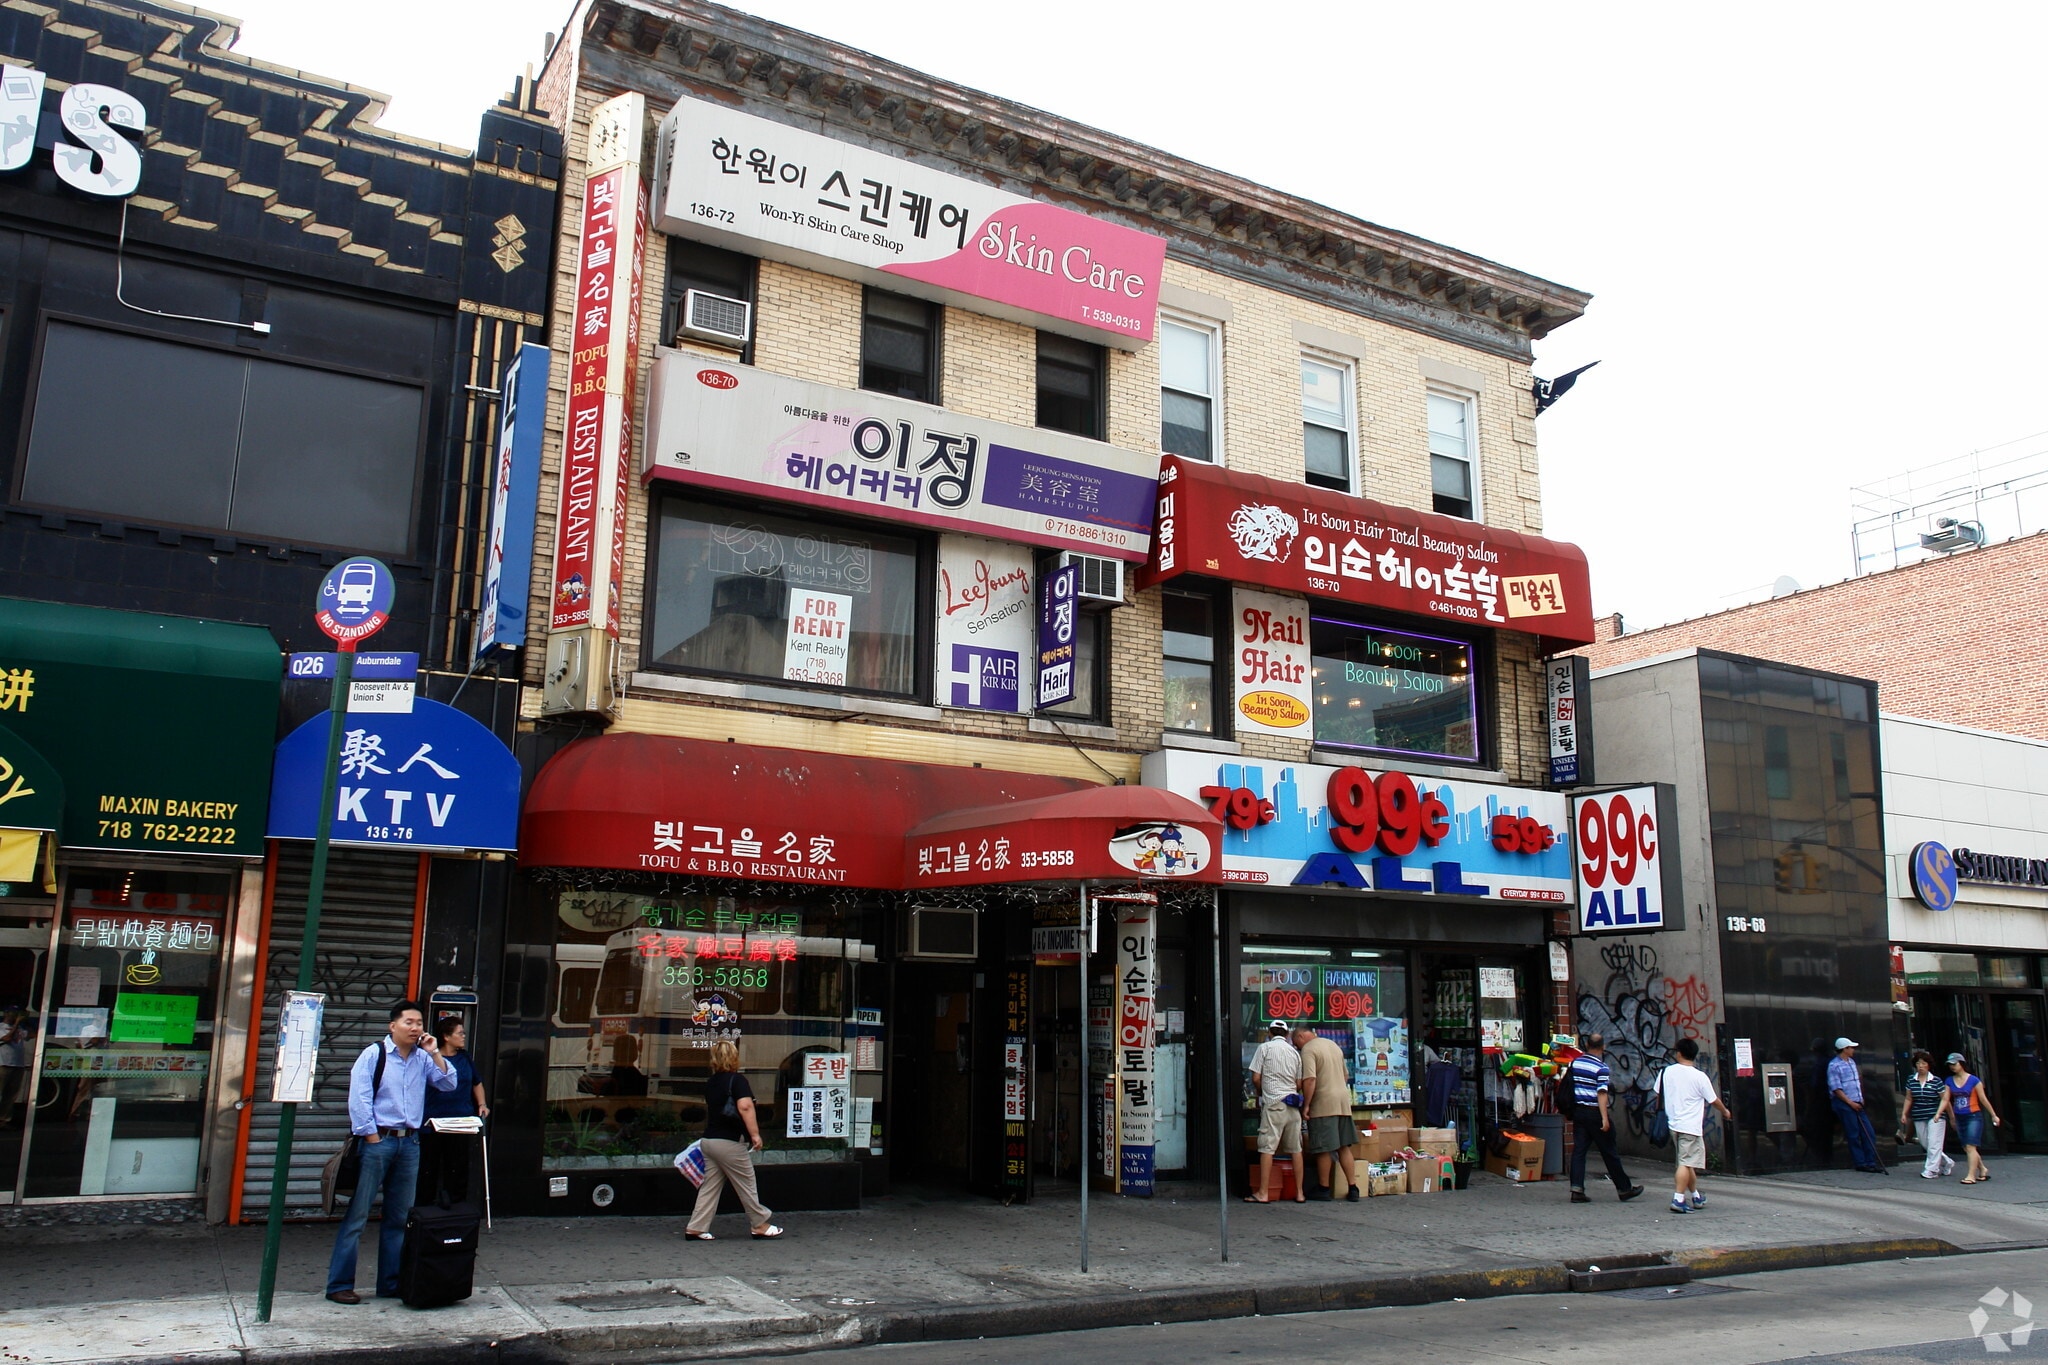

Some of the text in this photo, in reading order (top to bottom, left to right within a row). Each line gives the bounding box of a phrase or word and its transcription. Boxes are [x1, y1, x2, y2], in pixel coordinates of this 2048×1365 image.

[711, 137, 969, 249] 한원이 스킨케어
[690, 202, 735, 224] 136-72
[759, 202, 905, 254] Won-Yi Skin Care Shop
[978, 221, 1146, 299] Skin Care
[1081, 306, 1142, 331] T. 539-0313
[574, 344, 609, 365] TOFU
[585, 365, 596, 377] &
[701, 372, 736, 388] 136-70
[833, 415, 850, 427] 위한
[850, 417, 980, 510] 이정
[1023, 463, 1102, 486] LEEJOUNG SENSATION
[1159, 464, 1178, 485] 인순
[565, 406, 598, 562] RESTAURANT
[786, 453, 922, 508] 헤어커커
[1020, 473, 1100, 504] 美容室
[1018, 492, 1100, 513] HAIRSTUDIO
[1159, 492, 1174, 571] 미용실
[1302, 508, 1499, 564] In Soon Hair Total Beauty Salon
[1307, 576, 1340, 592] 136-70
[1053, 569, 1074, 643] 이정
[1509, 579, 1563, 612] 미용실
[554, 609, 590, 624] 353-5858
[805, 598, 837, 617] FOR
[967, 599, 1027, 635] Sensation
[1438, 602, 1478, 618] 461-0003
[320, 613, 382, 638] NO STANDING
[793, 615, 845, 639] RENT
[1242, 607, 1304, 645] Nail
[790, 639, 846, 658] Kent Realty
[292, 656, 324, 676] Q26
[356, 656, 402, 666] Auburndale
[806, 658, 827, 670] (718)
[1241, 648, 1305, 684] Hair
[788, 667, 843, 685] 353-8368
[982, 676, 1017, 691] KIR KIR
[1043, 671, 1068, 692] Hair
[1345, 661, 1443, 694] Beauty Salon
[353, 693, 384, 702] Union St
[354, 683, 409, 692] Roosevelt Av &
[1042, 688, 1068, 699] KIR KIR
[1243, 703, 1305, 721] Beauty Salon
[1256, 694, 1291, 708] In Soon
[340, 728, 460, 779] 聚人
[1553, 756, 1576, 765] UNISEX
[1555, 764, 1574, 773] NAILS
[100, 796, 238, 820] MAXIN BAKERY
[337, 786, 456, 827] KTV
[1200, 785, 1276, 830] 79¢
[1327, 765, 1450, 857] 99¢
[98, 821, 236, 844] 718 762-2222
[653, 820, 836, 865] 빛고을 名家
[1492, 814, 1555, 855] 59¢
[1579, 793, 1656, 888] 99¢
[918, 836, 1011, 876] 빛고을 名家
[1021, 850, 1074, 868] 353-5858
[639, 853, 847, 882] TOFU & B.B.Q RESTAURANT
[1240, 872, 1248, 880] OR
[1252, 873, 1267, 881] LESS
[1291, 852, 1490, 896] ALL
[1503, 889, 1528, 898] EVERYDAY
[1585, 887, 1662, 927] ALL
[1726, 916, 1766, 933] 136-68
[1047, 929, 1074, 950] INCOME
[663, 966, 768, 988] 353-5858
[1267, 968, 1312, 985] TODO
[1268, 989, 1314, 1018] 99¢
[1328, 990, 1373, 1018] 99¢
[808, 1057, 848, 1081] 족발
[792, 1091, 803, 1134] 마파두부
[832, 1096, 844, 1134] 삼계탕
[1120, 1109, 1149, 1118] In Soon
[1122, 1121, 1146, 1132] Beauty
[1123, 1133, 1145, 1142] Salon
[1121, 1152, 1147, 1161] UNISEX
[1124, 1166, 1145, 1174] NAILS
